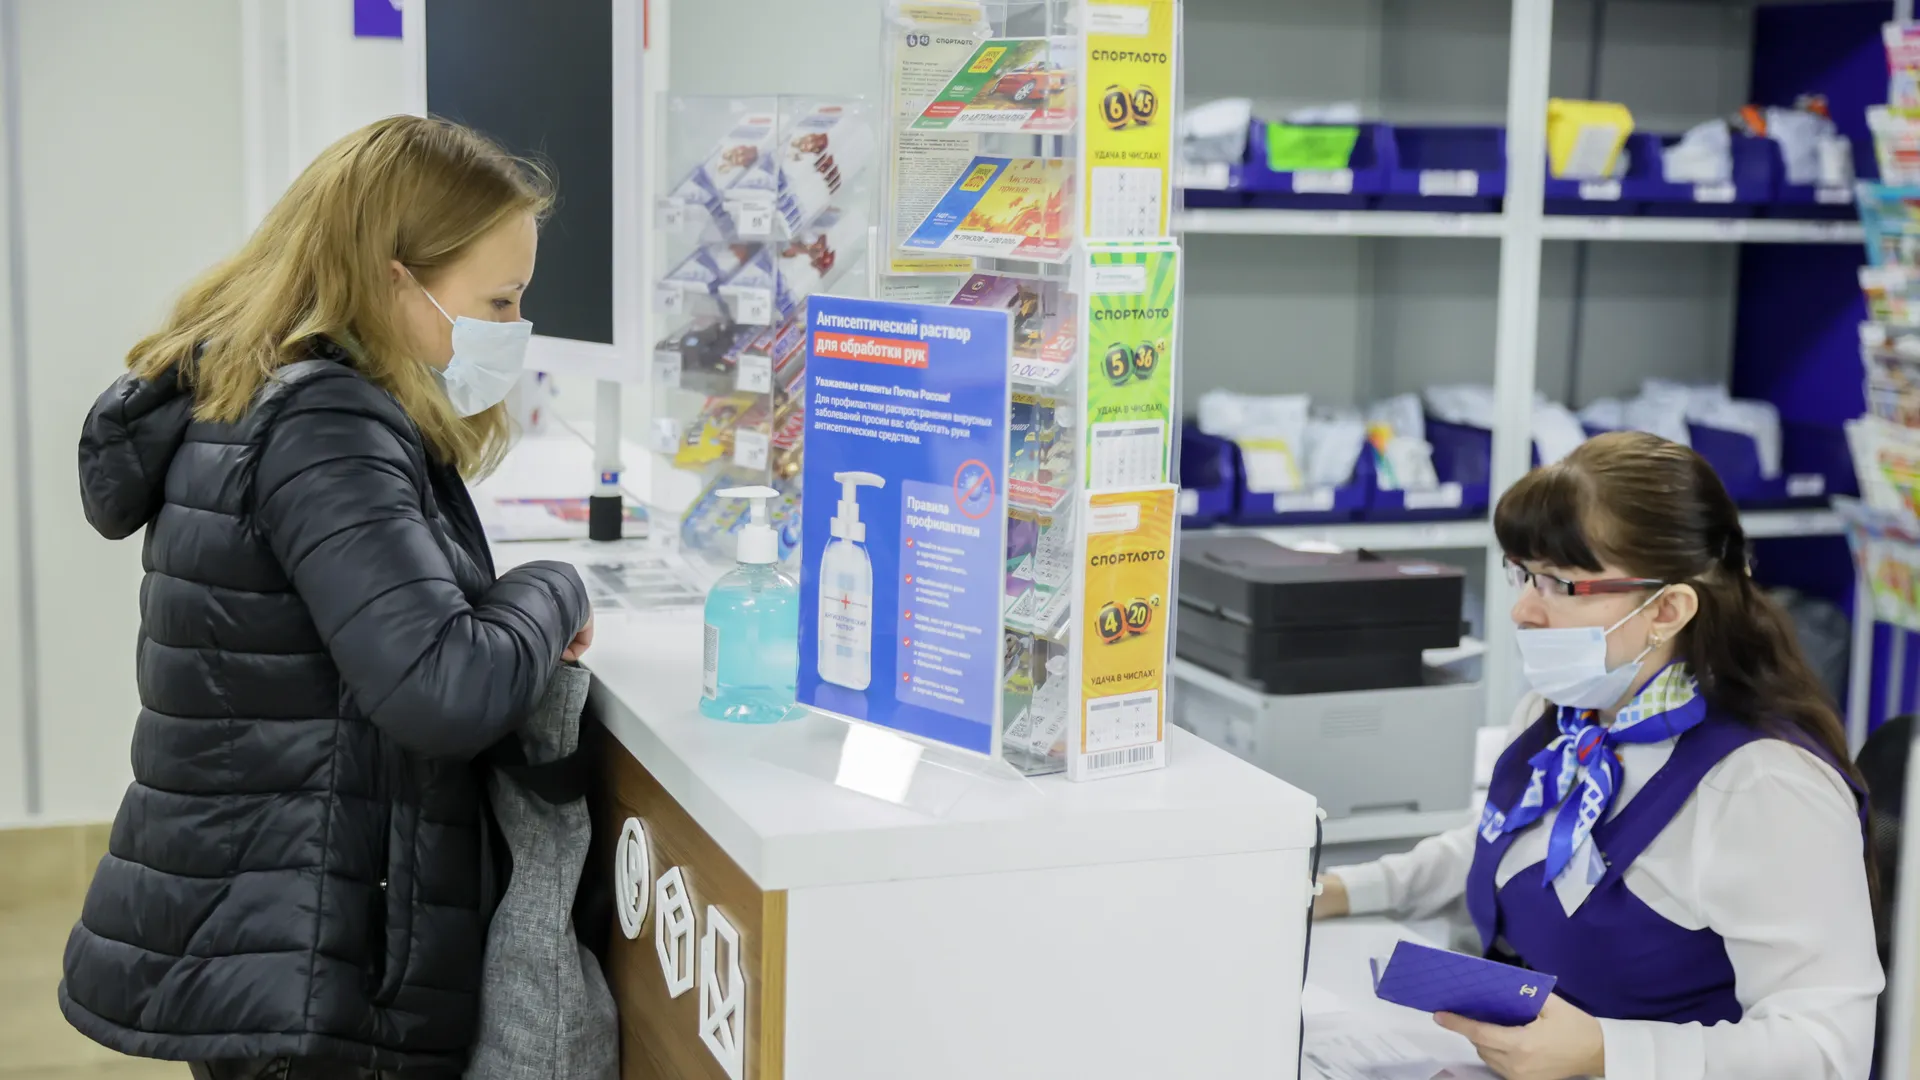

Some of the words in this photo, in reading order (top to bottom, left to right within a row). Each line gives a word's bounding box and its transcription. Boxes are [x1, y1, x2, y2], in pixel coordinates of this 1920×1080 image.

[935, 37, 974, 46] СПОРТЛОТО
[1091, 49, 1168, 64] СПОРТЛОТО
[1109, 95, 1123, 119] 6
[1135, 91, 1152, 114] 45
[1094, 151, 1119, 160] УДАЧА
[1121, 151, 1127, 160] В
[1128, 151, 1161, 161] ЧИСЛАХ!
[1094, 308, 1170, 321] СПОРТЛОТО
[816, 310, 918, 335] Антисептический
[919, 323, 972, 344] раствор
[816, 338, 838, 353] для
[839, 338, 902, 359] обработки
[903, 347, 926, 365] рук
[1111, 352, 1125, 376] 5
[1136, 348, 1153, 368] 36
[815, 375, 859, 391] Уважаемые
[860, 383, 892, 396] клиенты
[893, 385, 919, 399] Почты
[920, 389, 951, 403] России!
[814, 393, 830, 405] Для
[831, 397, 885, 412] профилактики
[885, 402, 952, 421] распространения
[953, 413, 993, 427] вирусных
[1096, 406, 1122, 416] УДАЧА
[1123, 405, 1129, 414] В
[1130, 403, 1163, 413] ЧИСЛАХ!
[814, 407, 861, 422] заболеваний
[861, 414, 890, 427] просим
[891, 419, 905, 429] вас
[905, 420, 950, 436] обработать
[950, 427, 971, 439] руки
[814, 421, 878, 438] антисептическим
[878, 430, 922, 445] средством.
[907, 495, 950, 515] Правила
[906, 514, 980, 538] профилактики
[1090, 549, 1165, 567] СПОРТЛОТО
[1104, 611, 1118, 632] 4
[1129, 605, 1147, 625] 20
[1091, 674, 1115, 686] УДАЧА
[1116, 673, 1122, 682] В
[1123, 669, 1156, 680] ЧИСЛАХ!
